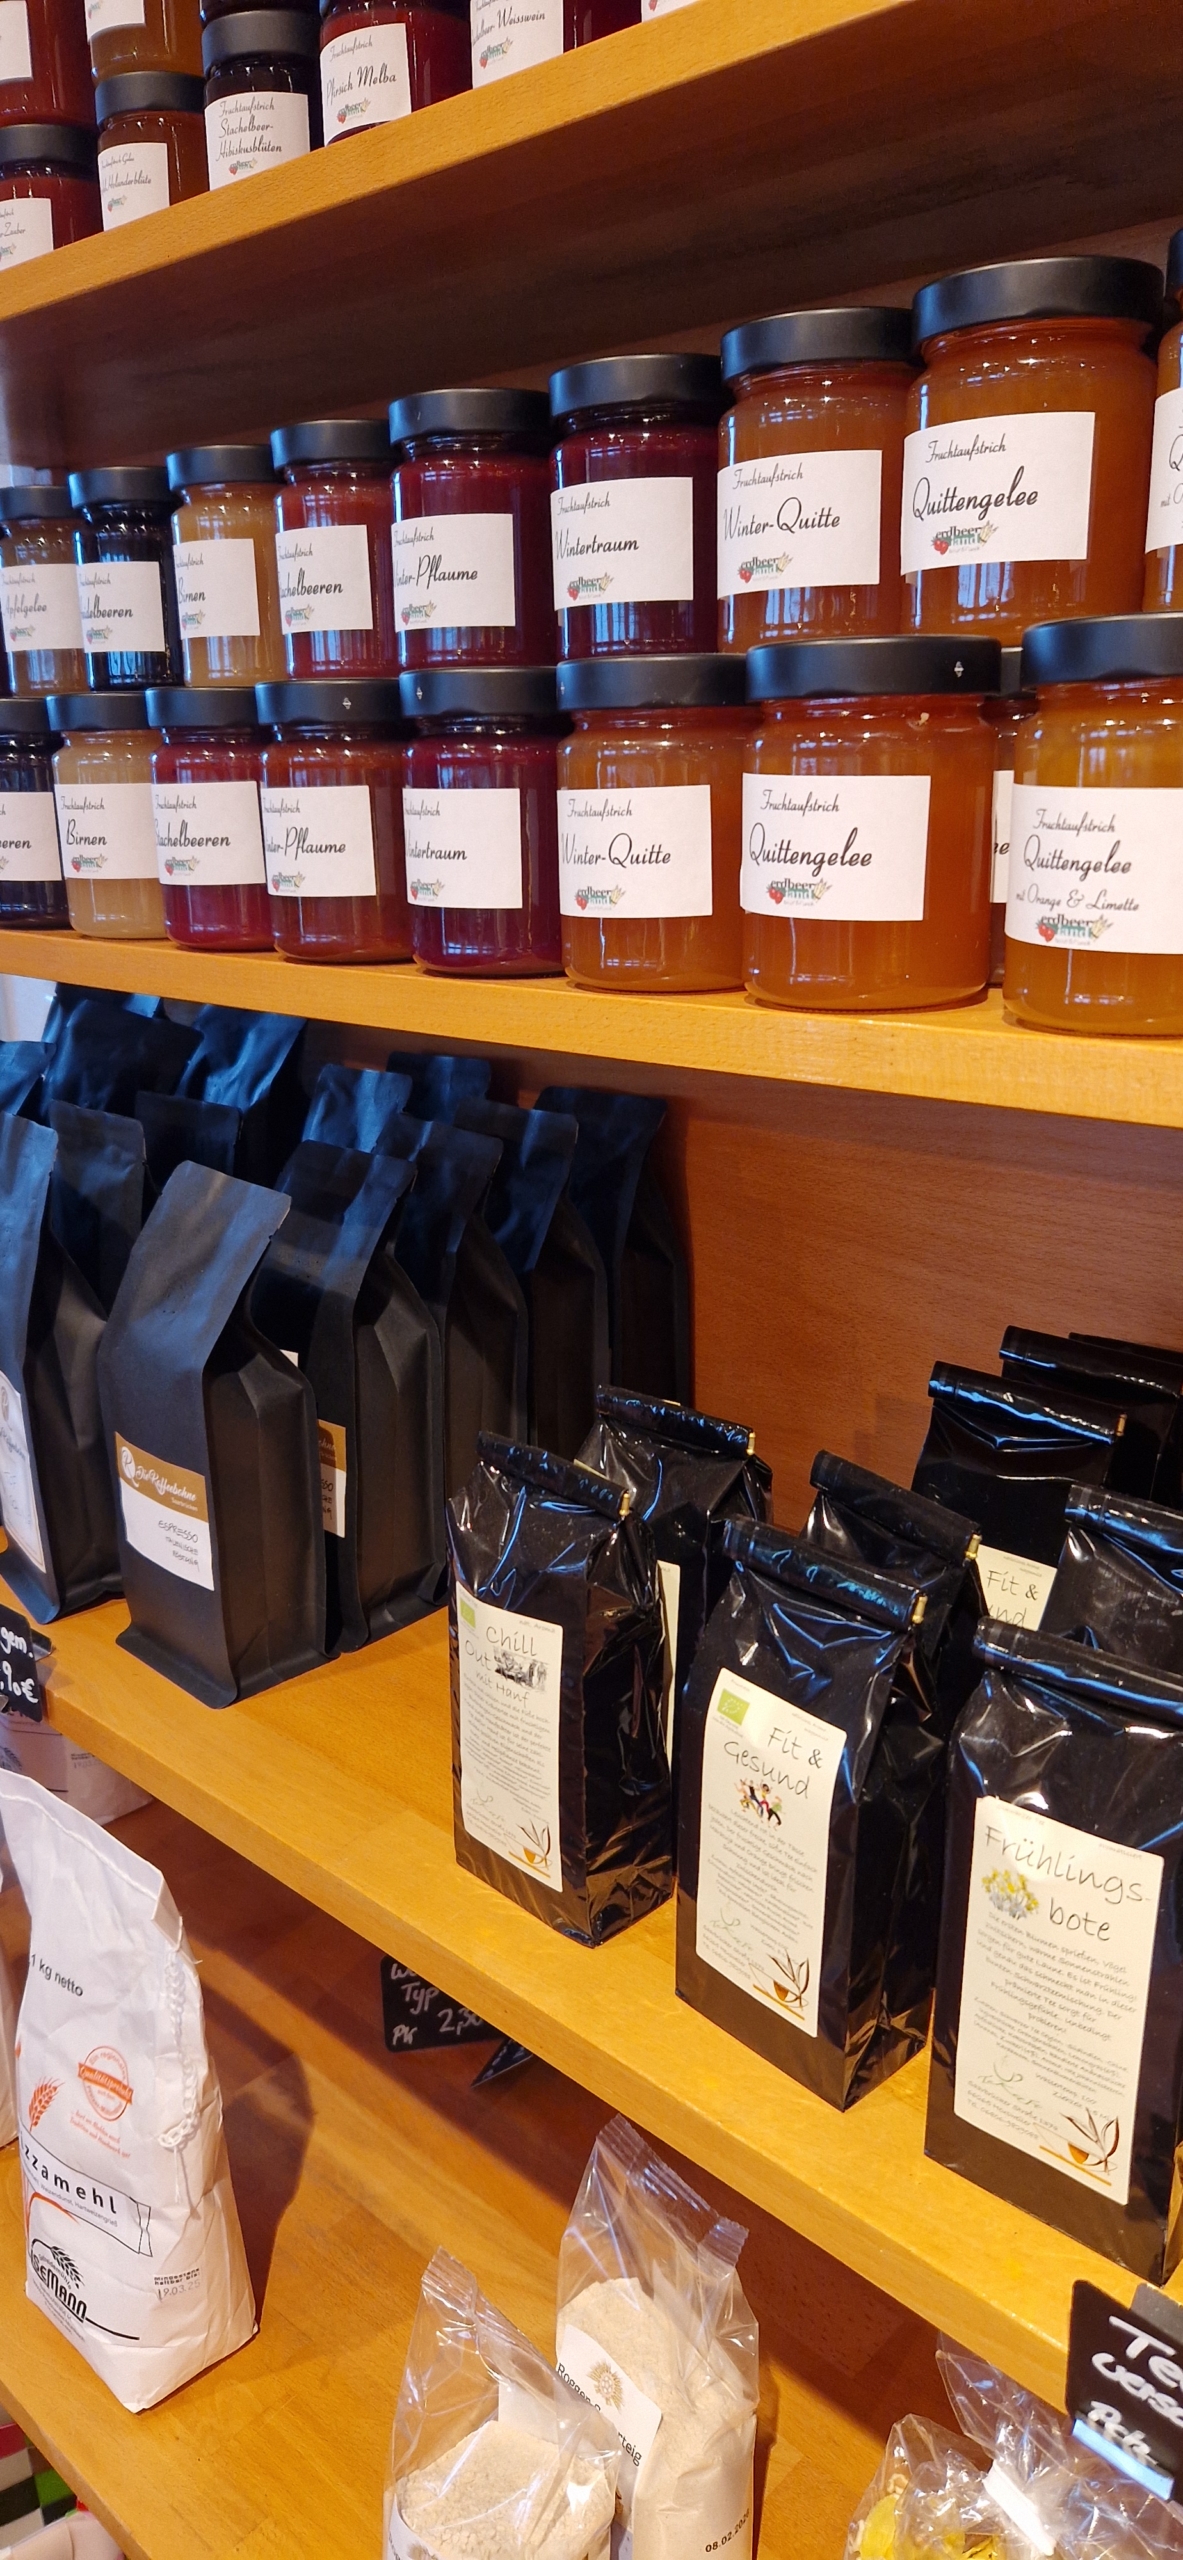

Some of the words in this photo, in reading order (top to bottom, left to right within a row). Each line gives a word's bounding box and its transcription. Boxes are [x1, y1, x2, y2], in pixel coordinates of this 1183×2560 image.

[357, 62, 397, 88] Melba
[219, 95, 275, 118] Fruchtaufstrich
[925, 432, 1007, 463] Fruchtaufstrich
[732, 462, 804, 490] Fruchtaufstrich
[556, 490, 611, 516] Fruchtaufstrich
[912, 465, 1039, 521] Quittengelee
[723, 496, 841, 541] Winter-Quitte
[935, 525, 982, 539] erdbeer
[555, 527, 640, 561] Wintertraum
[740, 556, 779, 570] erdbeer
[278, 566, 344, 599] achelbeeren
[567, 798, 633, 821] Fruchtaufstrich
[760, 789, 840, 817] Fruchtaufstrich
[66, 818, 108, 846] Birnen
[1033, 808, 1116, 837] Fruchtaufstrich
[266, 826, 347, 861] inter-Pflaume
[561, 832, 672, 869] Winter-Quitte
[749, 822, 873, 878] Quittengelee
[1023, 834, 1133, 882] Quittengelee
[770, 877, 820, 890] erdbeer
[1027, 883, 1062, 912] Orange
[1066, 889, 1085, 909] &
[1086, 888, 1140, 912] Limette
[1041, 913, 1094, 928] erdbeer
[985, 1569, 1020, 1597] Fit
[1025, 1583, 1040, 1601] &
[464, 1639, 492, 1672] Out
[486, 1625, 538, 1657] Chill
[0, 1660, 39, 1704] ,90€
[495, 1682, 530, 1709] Hanf
[767, 1726, 803, 1760] Fit
[808, 1747, 824, 1770] &
[723, 1740, 811, 1800] Gesund
[985, 1824, 1151, 1905] Frühlings-
[1049, 1896, 1112, 1942] bote
[31, 1953, 37, 1967] 1
[39, 1959, 51, 1981] kg
[54, 1973, 84, 1998] netto
[402, 1981, 440, 2015] Typ
